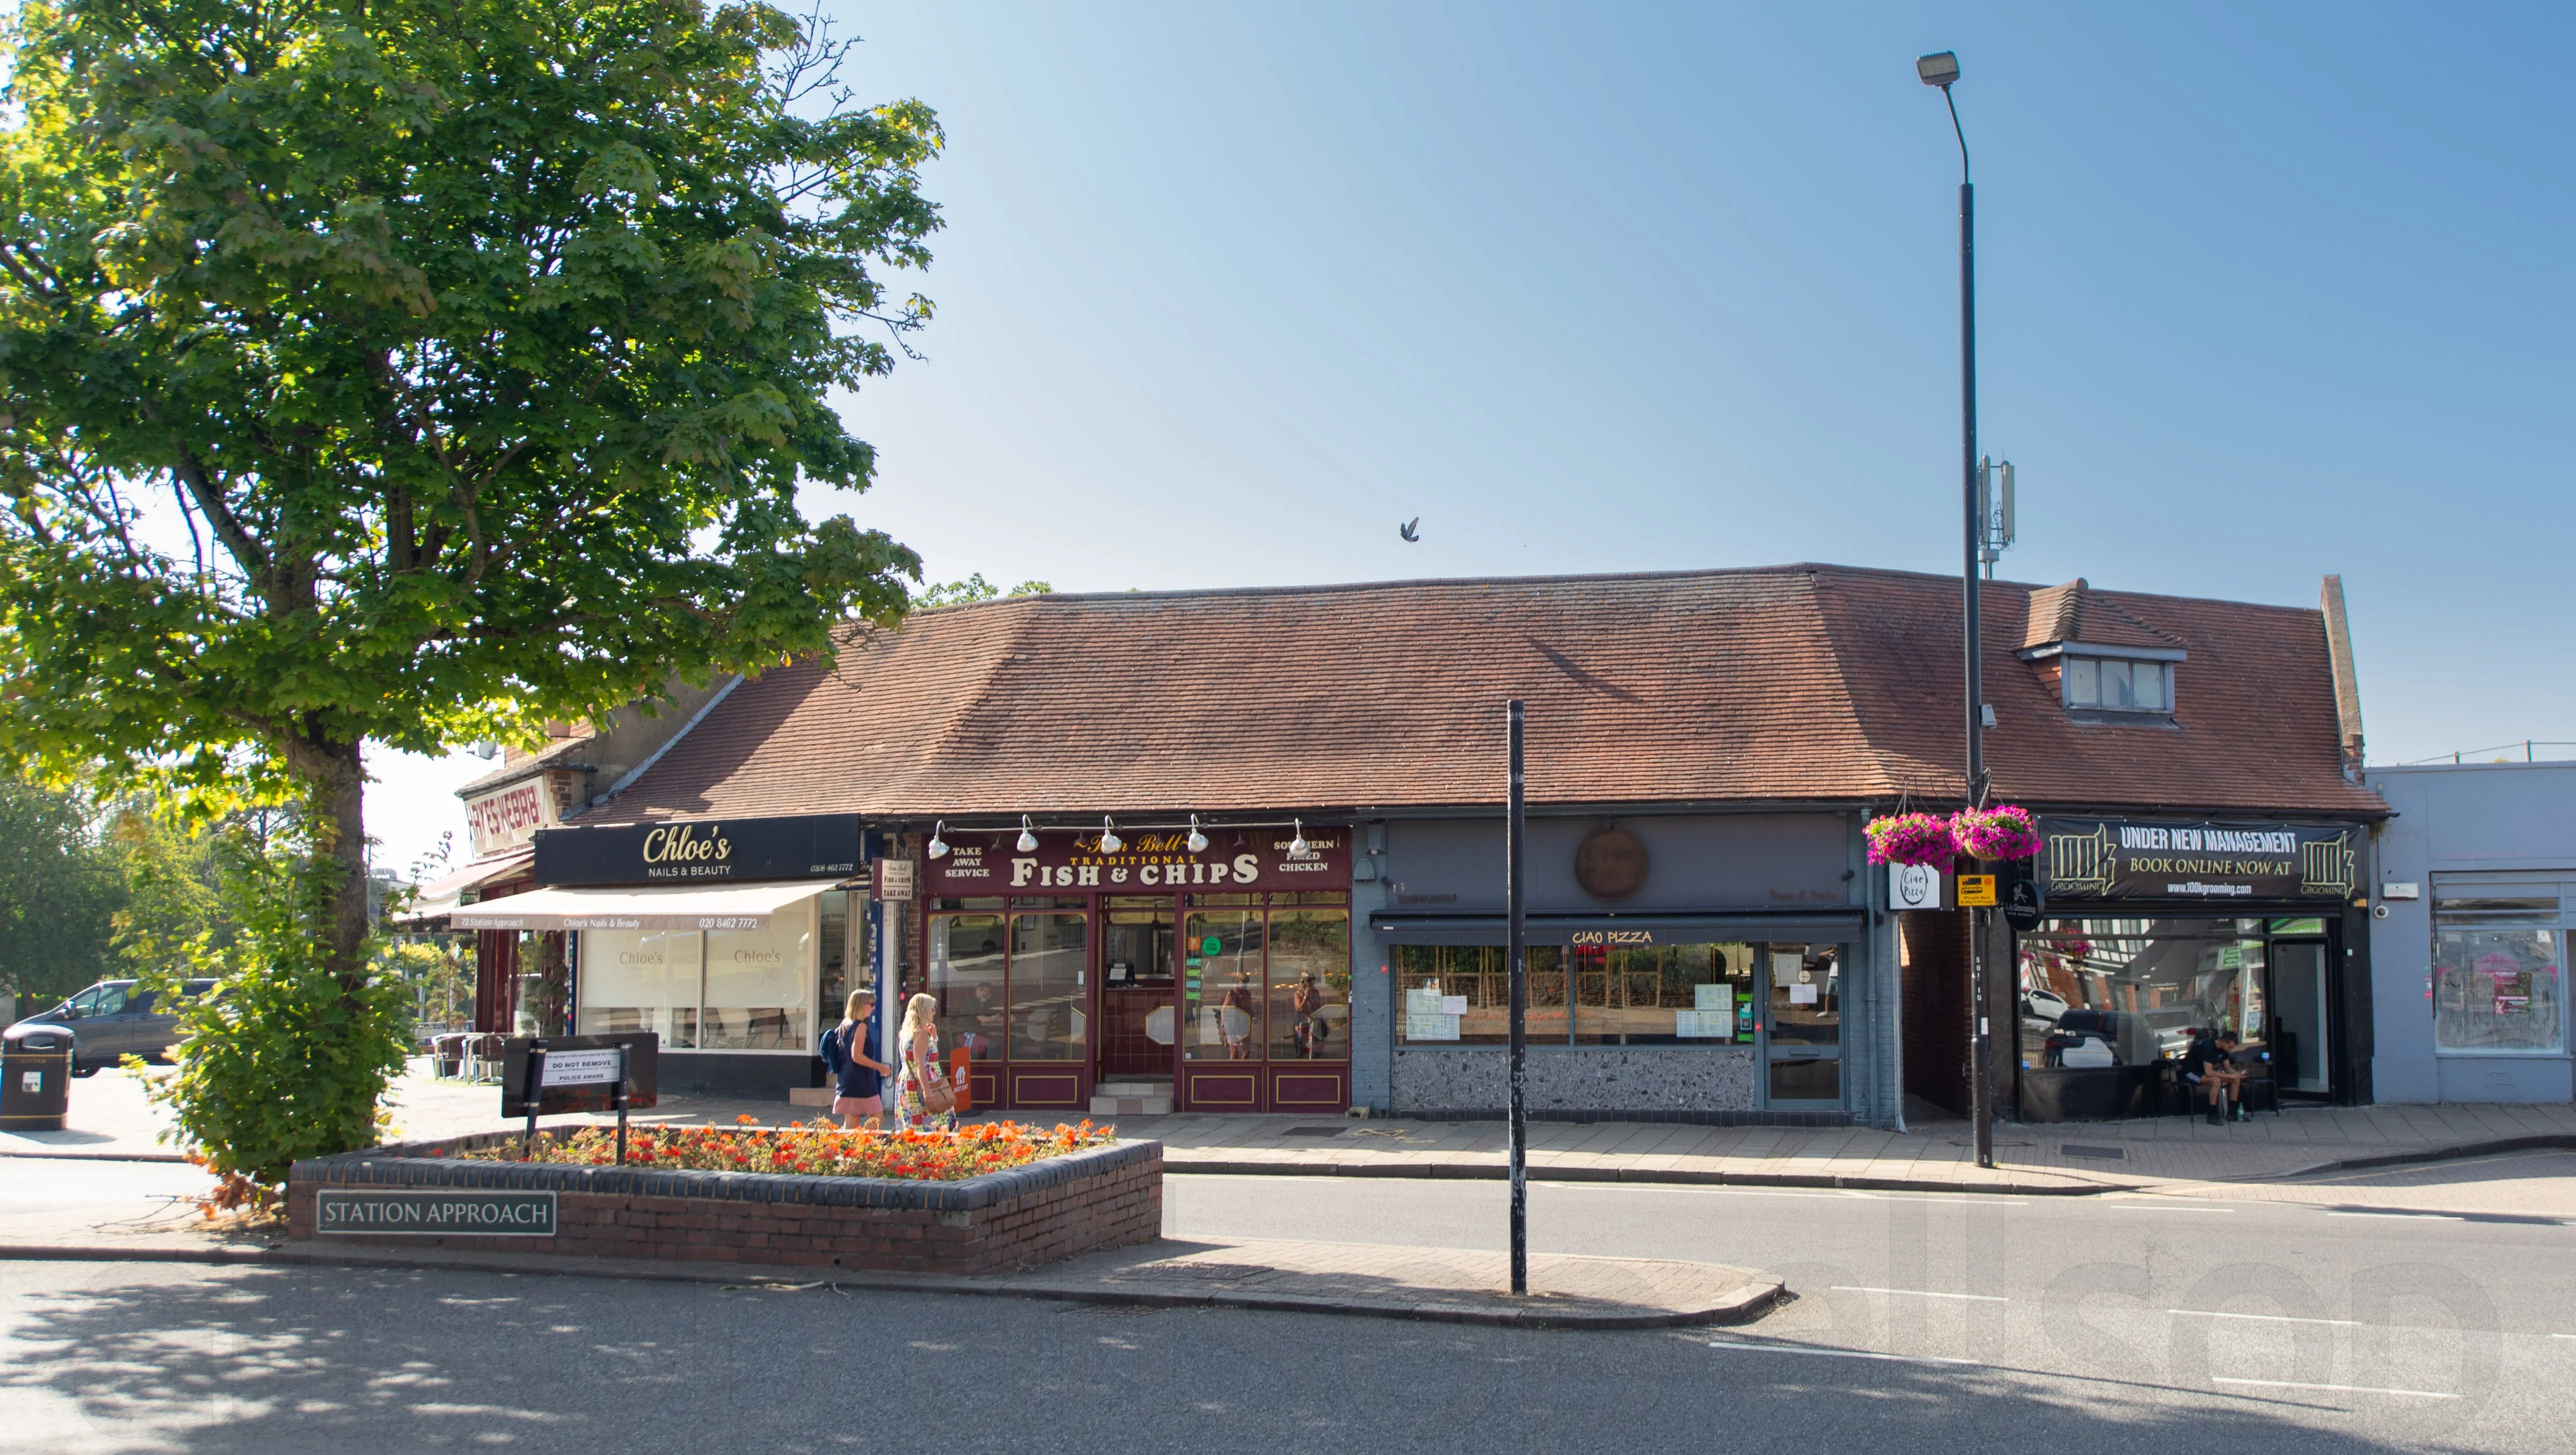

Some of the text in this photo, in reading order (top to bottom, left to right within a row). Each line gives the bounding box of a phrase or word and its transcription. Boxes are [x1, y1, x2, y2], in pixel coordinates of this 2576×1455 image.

[497, 785, 540, 832] KEBAB
[643, 825, 732, 863] Chloe's
[1136, 834, 1182, 852] Bell
[2120, 827, 2296, 853] UNDER NEW MANAGEMENT
[952, 847, 982, 856] TAKE
[1286, 852, 1321, 861] FED
[952, 858, 982, 867] AWAY
[1070, 855, 1196, 865] TRADITIONAL
[2130, 857, 2292, 875] BOOK ONLINE NOW AT
[649, 865, 731, 877] NAILS & BEAUTY
[945, 868, 990, 877] SERVICE
[1010, 854, 1259, 887] FISH & CHIPS
[1278, 862, 1329, 872] CHICKEN
[1904, 871, 1923, 884] Ciao
[1904, 885, 1923, 896] Pizza
[2167, 881, 2251, 896] www.100kgrooming.com
[461, 918, 524, 928] 72 Station Approach
[564, 918, 641, 929] Chloe's Nails & Beauty
[699, 918, 757, 928] 020 8462 7772
[1572, 931, 1653, 944] CIAO PIZZA
[620, 951, 663, 965] Chloe's
[734, 949, 781, 963] Chloe's
[325, 1202, 548, 1223] STATION APPROACH
